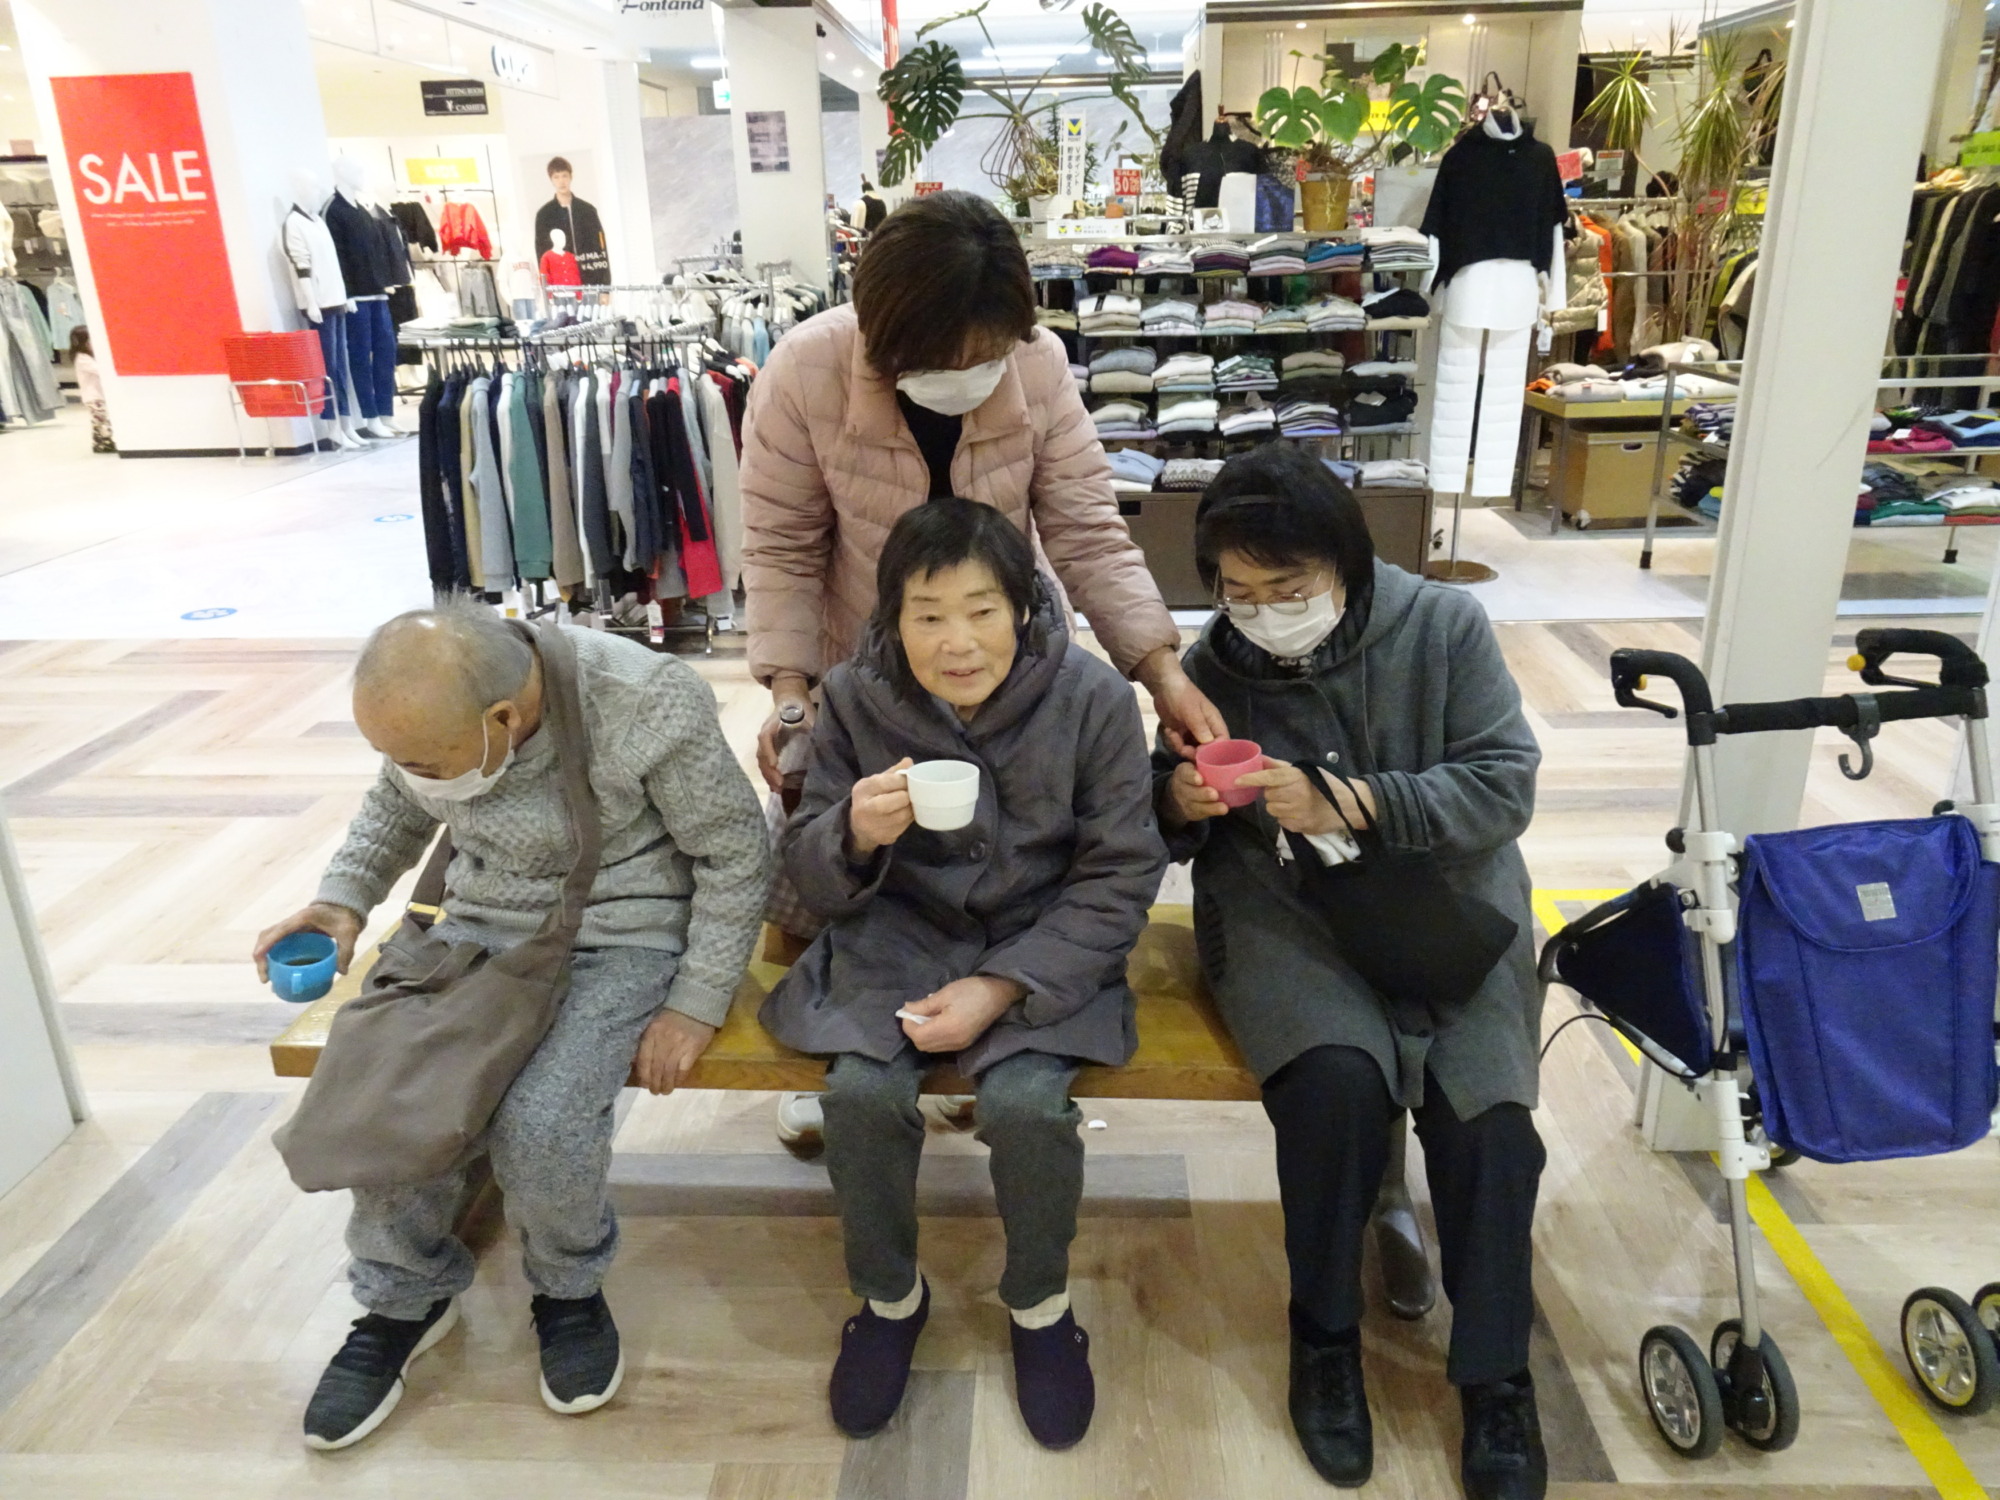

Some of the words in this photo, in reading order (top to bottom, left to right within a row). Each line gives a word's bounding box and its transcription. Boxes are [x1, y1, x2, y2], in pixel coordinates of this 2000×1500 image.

[455, 104, 487, 112] CASHIER
[79, 151, 207, 205] SALE
[586, 251, 607, 260] MA-1
